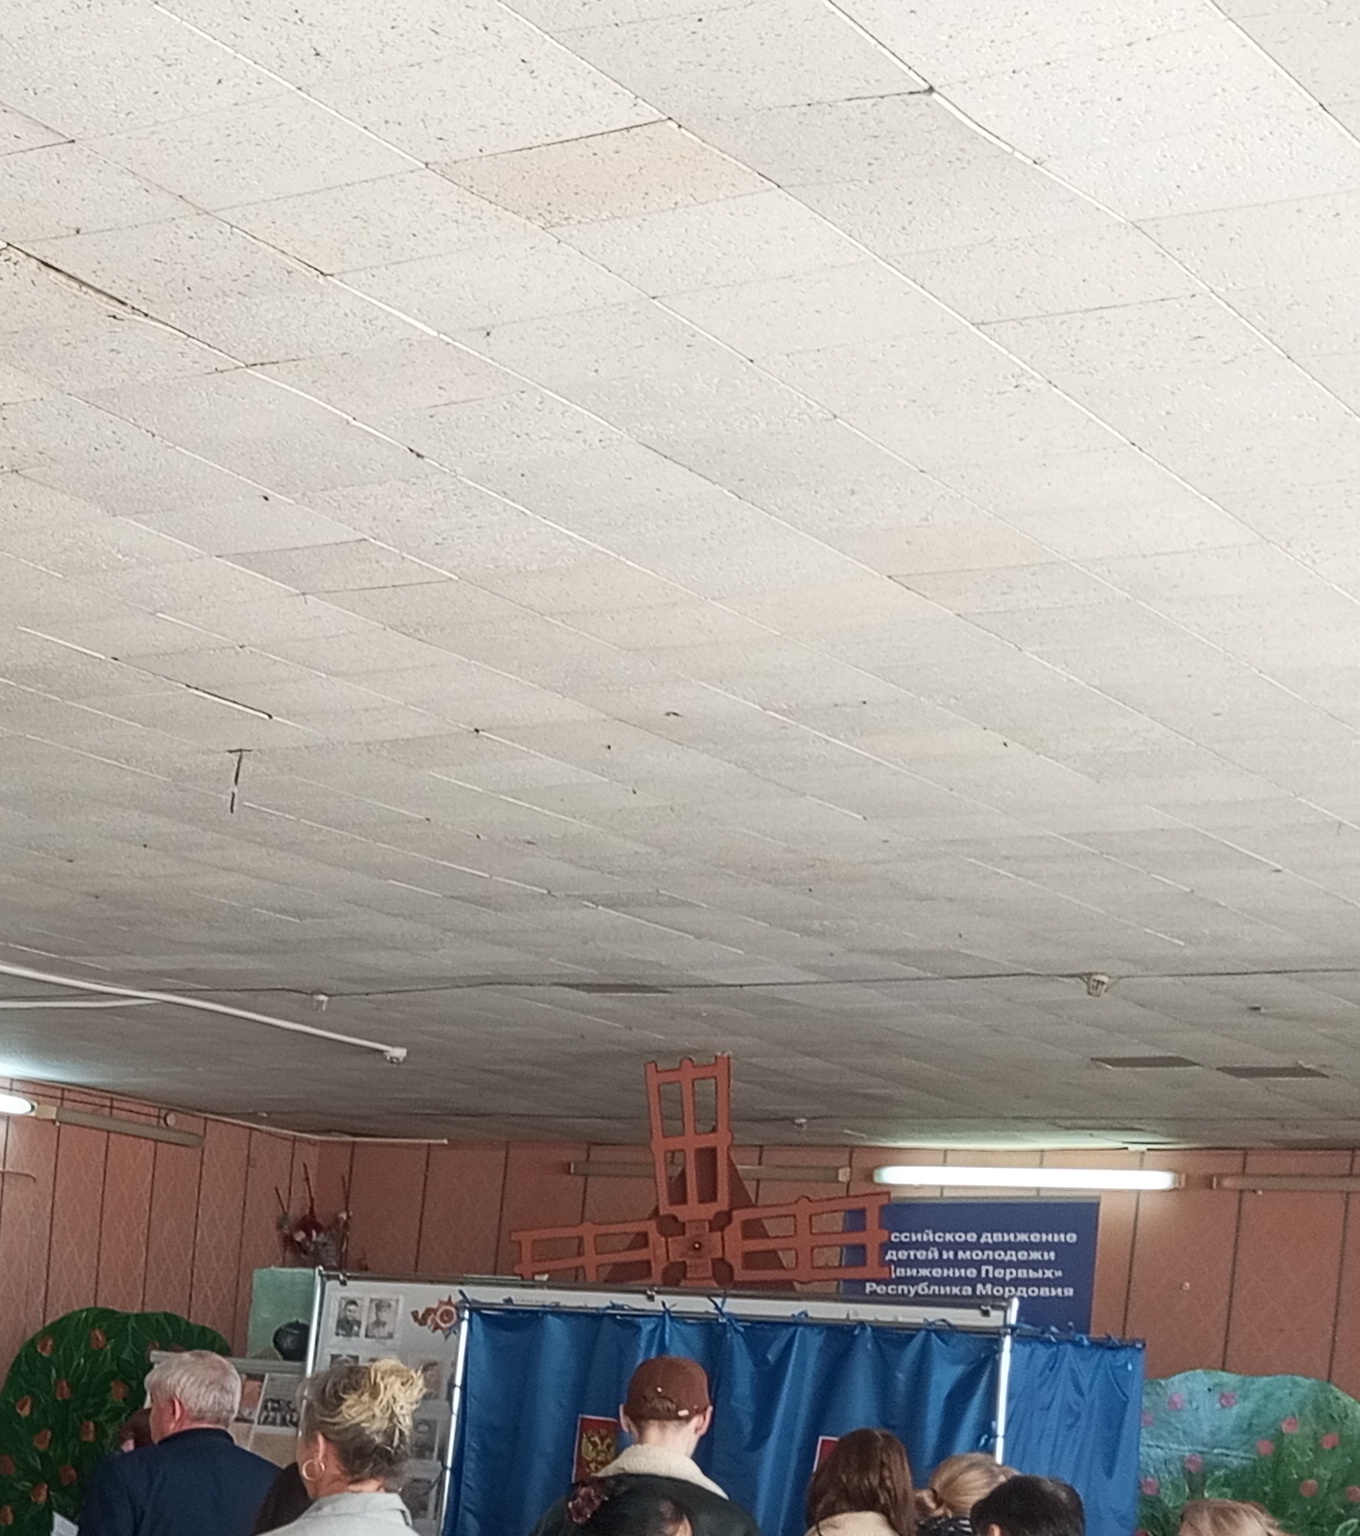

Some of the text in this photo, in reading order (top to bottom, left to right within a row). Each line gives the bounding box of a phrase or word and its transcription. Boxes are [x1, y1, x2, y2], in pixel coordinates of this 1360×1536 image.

[890, 1228, 1078, 1244] ссийское движение
[884, 1246, 1056, 1262] детей и молодежи
[890, 1263, 978, 1279] вижение
[864, 1281, 1075, 1298] Республика Мордовия
